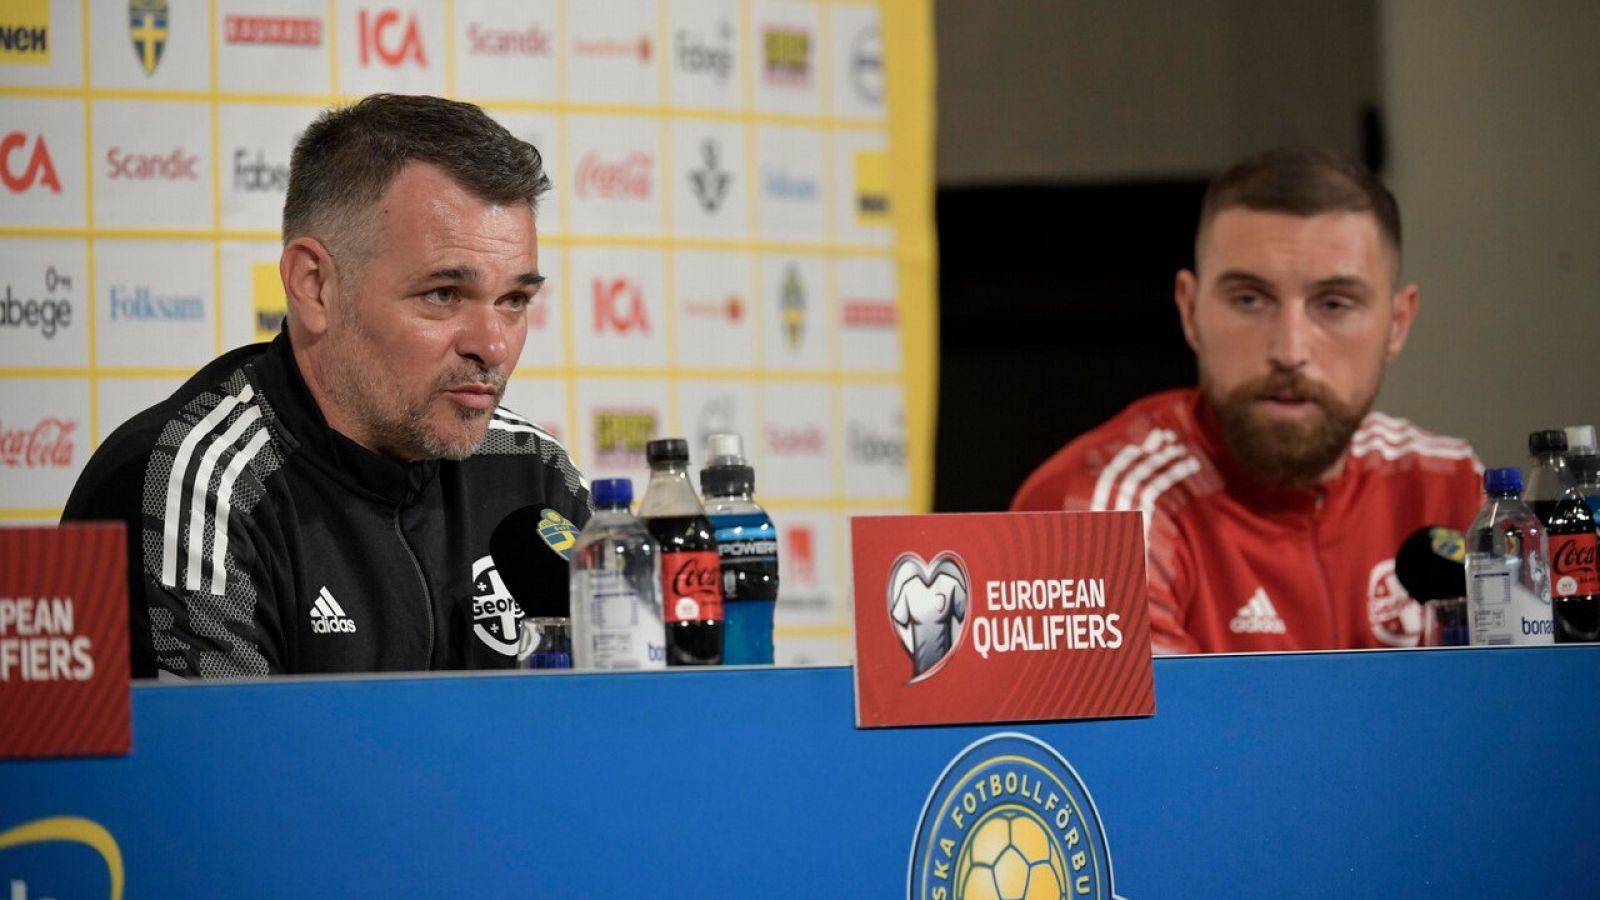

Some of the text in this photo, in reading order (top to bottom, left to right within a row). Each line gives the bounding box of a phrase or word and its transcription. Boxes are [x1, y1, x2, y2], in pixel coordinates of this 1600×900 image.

[358, 10, 427, 69] ICA
[0, 131, 62, 194] CA
[106, 147, 199, 180] Scandic
[110, 289, 204, 321] Folksam
[592, 275, 650, 337] ICA
[986, 578, 1106, 611] EUROPEAN
[0, 597, 74, 636] PEAN
[310, 618, 356, 634] adidas
[972, 613, 1122, 659] QUALIFIERS
[0, 635, 95, 682] FIERS
